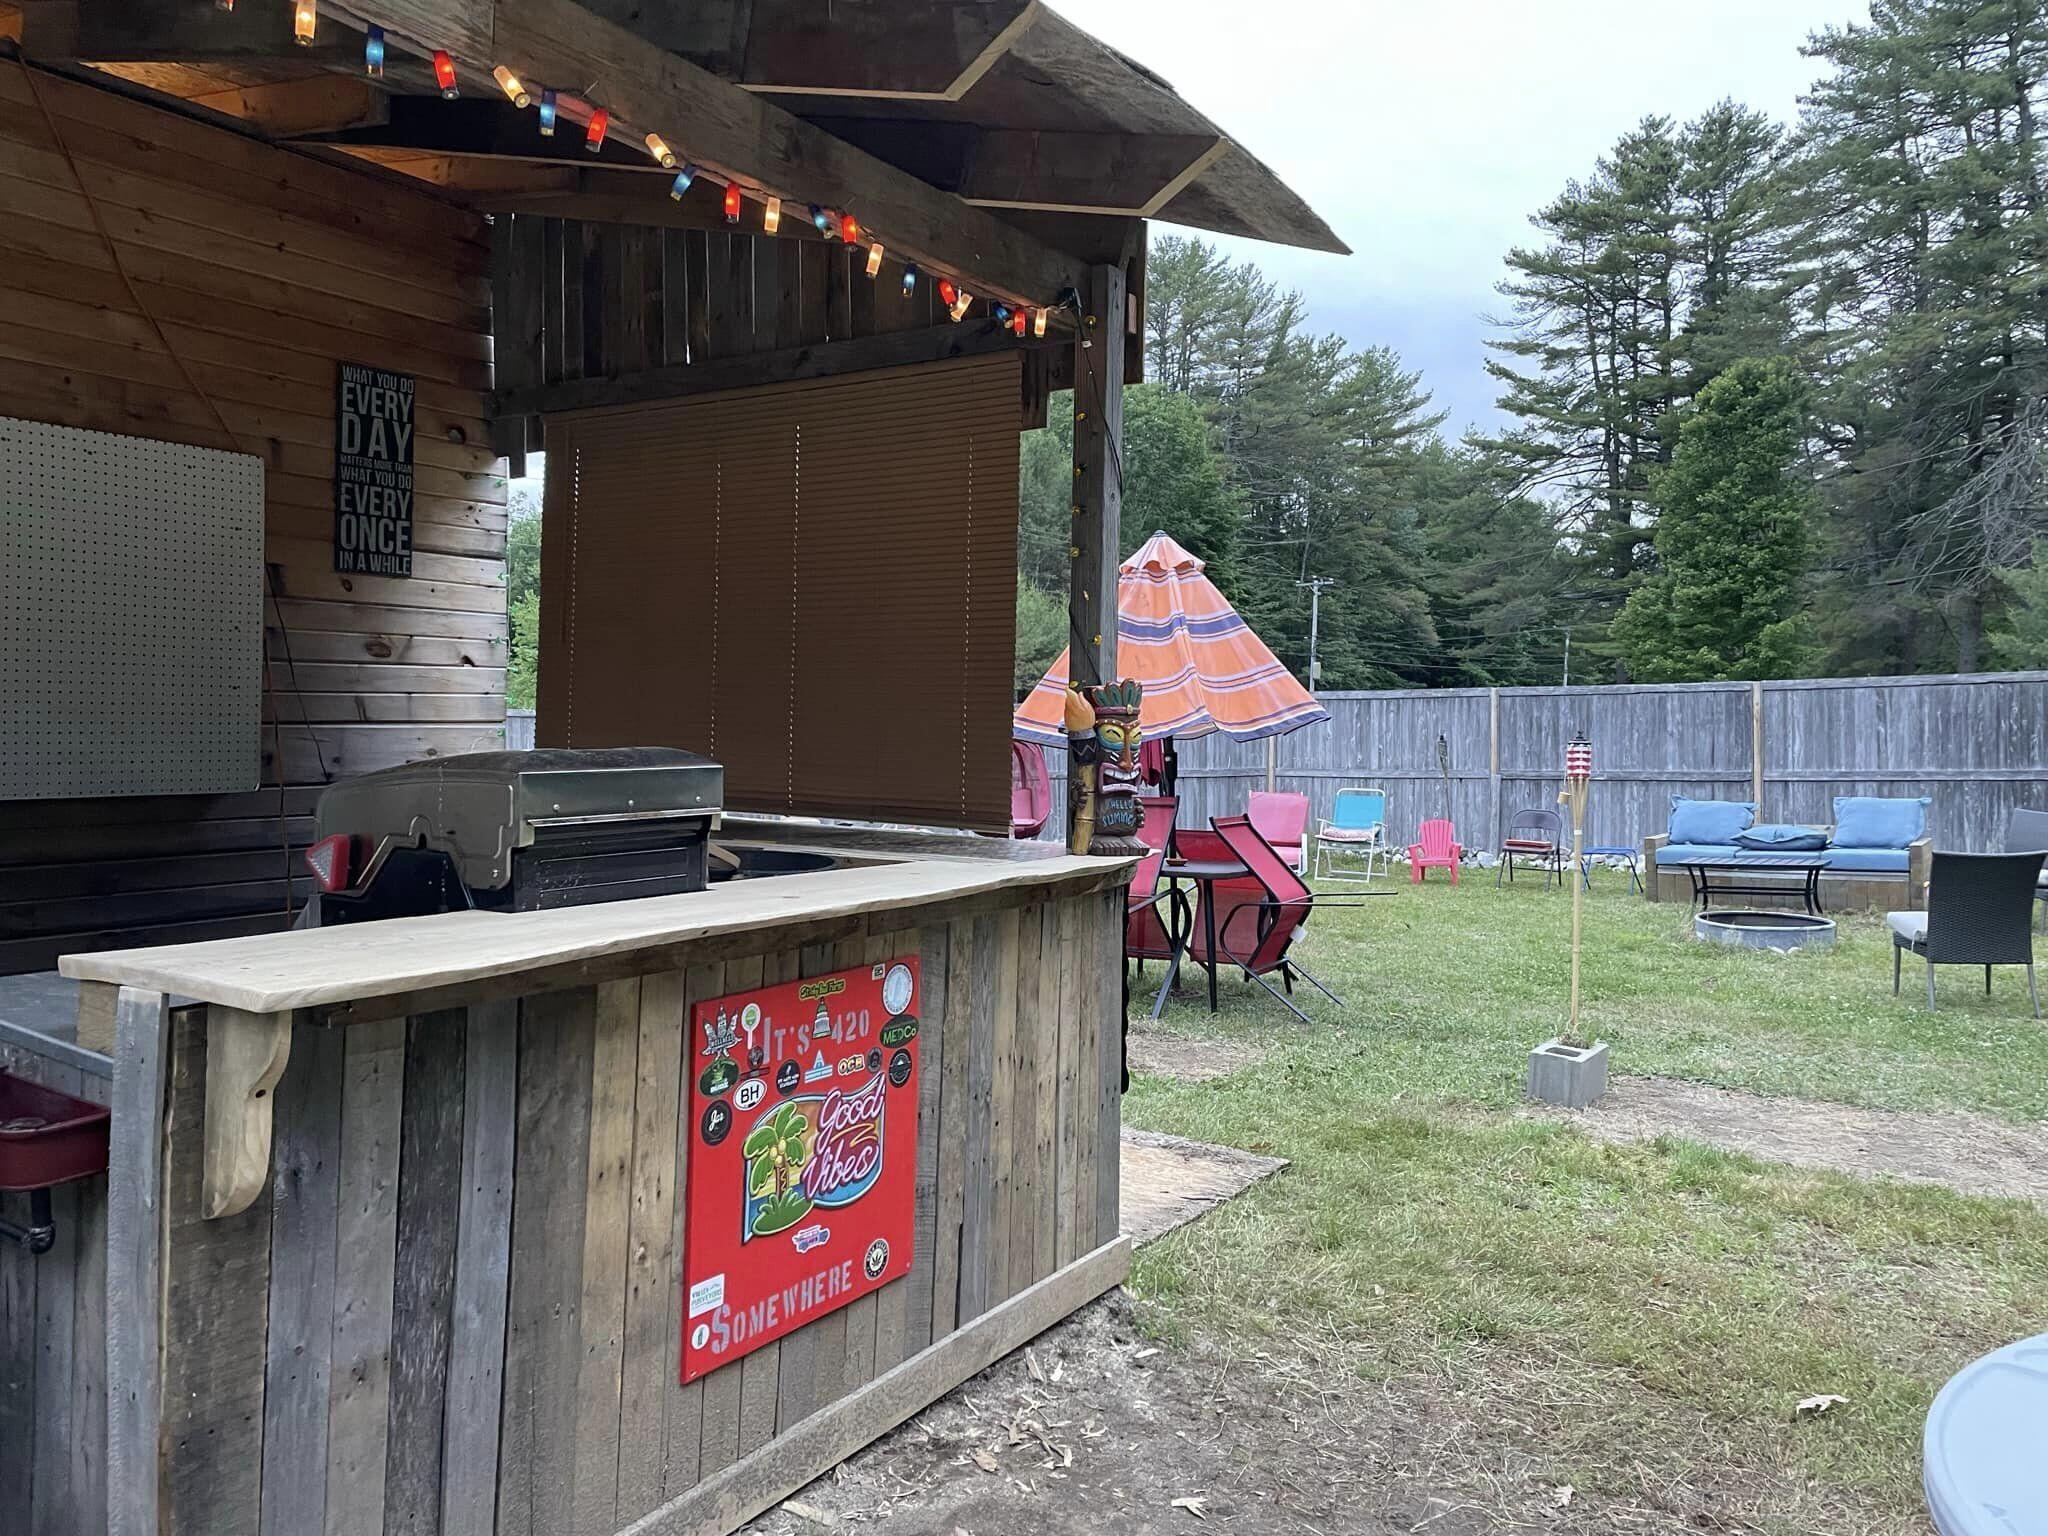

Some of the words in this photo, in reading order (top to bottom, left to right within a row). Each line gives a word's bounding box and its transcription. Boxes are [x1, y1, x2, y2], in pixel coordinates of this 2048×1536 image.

[342, 365, 374, 383] WHAT
[376, 371, 397, 390] YOU
[400, 378, 414, 394] DO
[342, 381, 413, 423] EVERY
[341, 412, 412, 463] DAY
[340, 453, 373, 469] MATTERS
[373, 458, 393, 472] MORE
[394, 462, 412, 475] THAN
[340, 466, 372, 484] WHAT
[374, 471, 395, 488] YOU
[398, 474, 412, 489] DO
[340, 482, 411, 520] EVERY
[340, 514, 411, 556] ONCE
[339, 549, 353, 569] IN
[356, 552, 367, 571] A
[369, 554, 411, 576] WHILE
[831, 1009, 870, 1045] 420
[838, 1055, 864, 1075] OCB
[740, 1084, 760, 1104] BH
[816, 1073, 886, 1155] Good
[802, 1139, 880, 1199] Vibes
